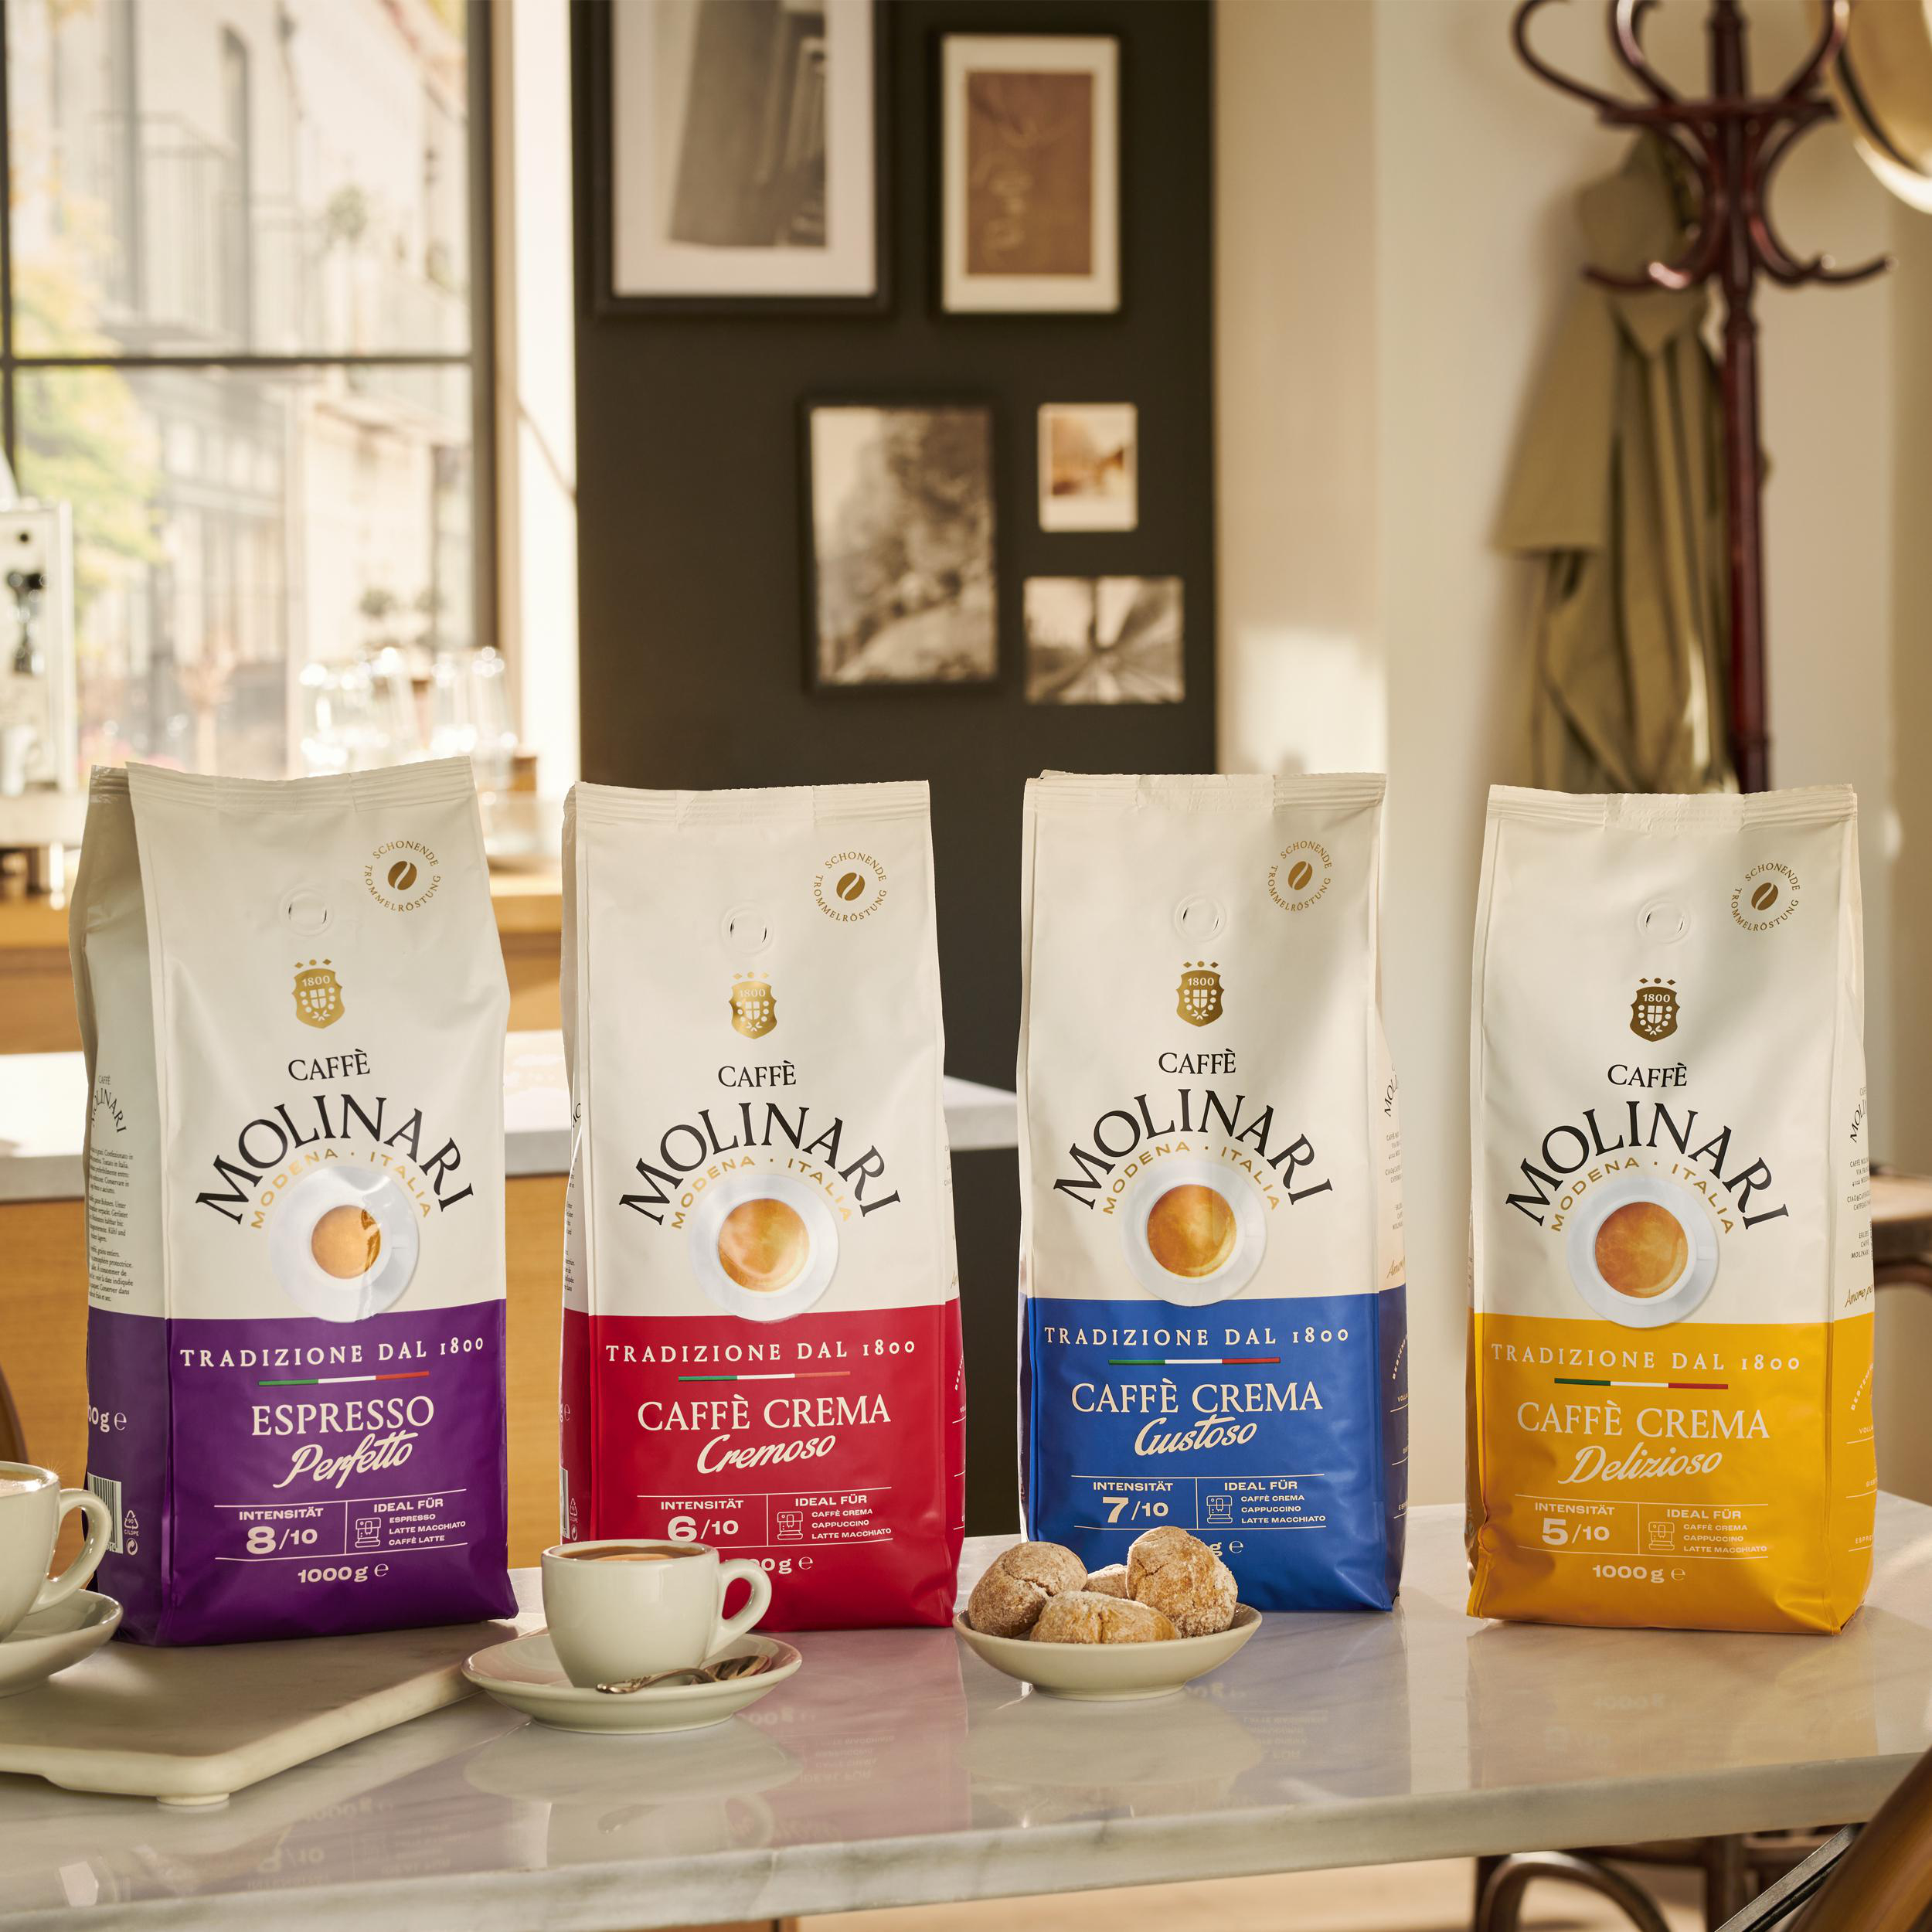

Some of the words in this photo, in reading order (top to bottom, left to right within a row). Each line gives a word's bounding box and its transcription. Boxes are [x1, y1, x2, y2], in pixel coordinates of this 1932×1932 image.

[372, 840, 439, 867] SCHONENDE
[825, 851, 887, 882] SCHONENDE
[1280, 840, 1332, 869] SCHONENDE
[364, 866, 440, 913] TROMMELRÖSTUNG
[1267, 866, 1331, 912] TROMMELRÖSTUNG
[1745, 862, 1800, 891] SCHONENDE
[814, 875, 887, 922] TROMMELRÖSTUNG
[1731, 888, 1798, 932] TROMMELRÖSTUNG
[301, 975, 331, 986] 1800
[1643, 994, 1670, 1002] 1800
[288, 1049, 370, 1081] CAFFÈ
[718, 1060, 796, 1087] CAFFÈ
[1158, 1048, 1236, 1074] CAFFÈ
[1607, 1063, 1688, 1087] CAFFÈ
[195, 1094, 473, 1225] MOLINARI
[1053, 1088, 1332, 1209] MOLINARI
[619, 1102, 900, 1226] MOLINARI
[1102, 1141, 1191, 1215] MODENA
[1221, 1146, 1280, 1210] ITALIA
[1506, 1101, 1789, 1230] MOLINARI
[250, 1148, 338, 1229] MODENA
[370, 1151, 431, 1218] ITALIA
[672, 1155, 755, 1229] MODENA
[788, 1158, 852, 1223] ITALIA
[1552, 1157, 1639, 1232] MODENA
[1672, 1163, 1734, 1235] ITALIA
[606, 1344, 781, 1362] TRADIZIONE
[798, 1342, 848, 1359] DAL
[862, 1339, 915, 1355] 1800
[1045, 1327, 1208, 1345] TRADIZIONE
[1226, 1328, 1276, 1345] DAL
[1293, 1328, 1349, 1344] 1800
[180, 1345, 362, 1368] TRADIZIONE
[379, 1341, 427, 1361] DAL
[440, 1337, 484, 1355] 1800
[1492, 1344, 1655, 1369] TRADIZIONE
[1672, 1353, 1725, 1370] DAL
[1742, 1355, 1800, 1370] 1800
[1071, 1378, 1178, 1413] CAFFÈ
[1192, 1381, 1323, 1413] CREMA
[252, 1396, 434, 1435] ESPRESSO
[638, 1394, 750, 1431] CAFFÈ
[764, 1394, 891, 1428] CREMA
[1517, 1400, 1622, 1436] CAFFÈ
[1636, 1407, 1770, 1439] CREMA
[1134, 1414, 1257, 1456] Gustoso
[273, 1430, 418, 1488] Perfetto
[696, 1434, 835, 1474] Cremoso
[1558, 1442, 1723, 1484] Delizioso
[1093, 1481, 1173, 1492] INTENSITÄT
[1224, 1481, 1265, 1491] IDEAL
[1270, 1479, 1298, 1489] FÜR
[239, 1507, 324, 1521] INTENSITÄT
[373, 1502, 414, 1513] IDEAL
[417, 1498, 443, 1509] FÜR
[661, 1498, 743, 1510] INTENSITÄT
[795, 1496, 836, 1507] IDEAL
[840, 1495, 867, 1505] FÜR
[1535, 1502, 1614, 1515] INTENSITÄT
[1667, 1509, 1709, 1519] IDEAL
[1713, 1509, 1741, 1519] FÜR
[389, 1514, 436, 1523] ESPRESSO
[417, 1520, 466, 1532] MACCHIATO
[812, 1519, 869, 1528] CAPPUCCINO
[843, 1528, 891, 1538] MACCHIATO
[389, 1537, 417, 1546] CAFFÈ
[1714, 1546, 1767, 1554] MACCHIATO
